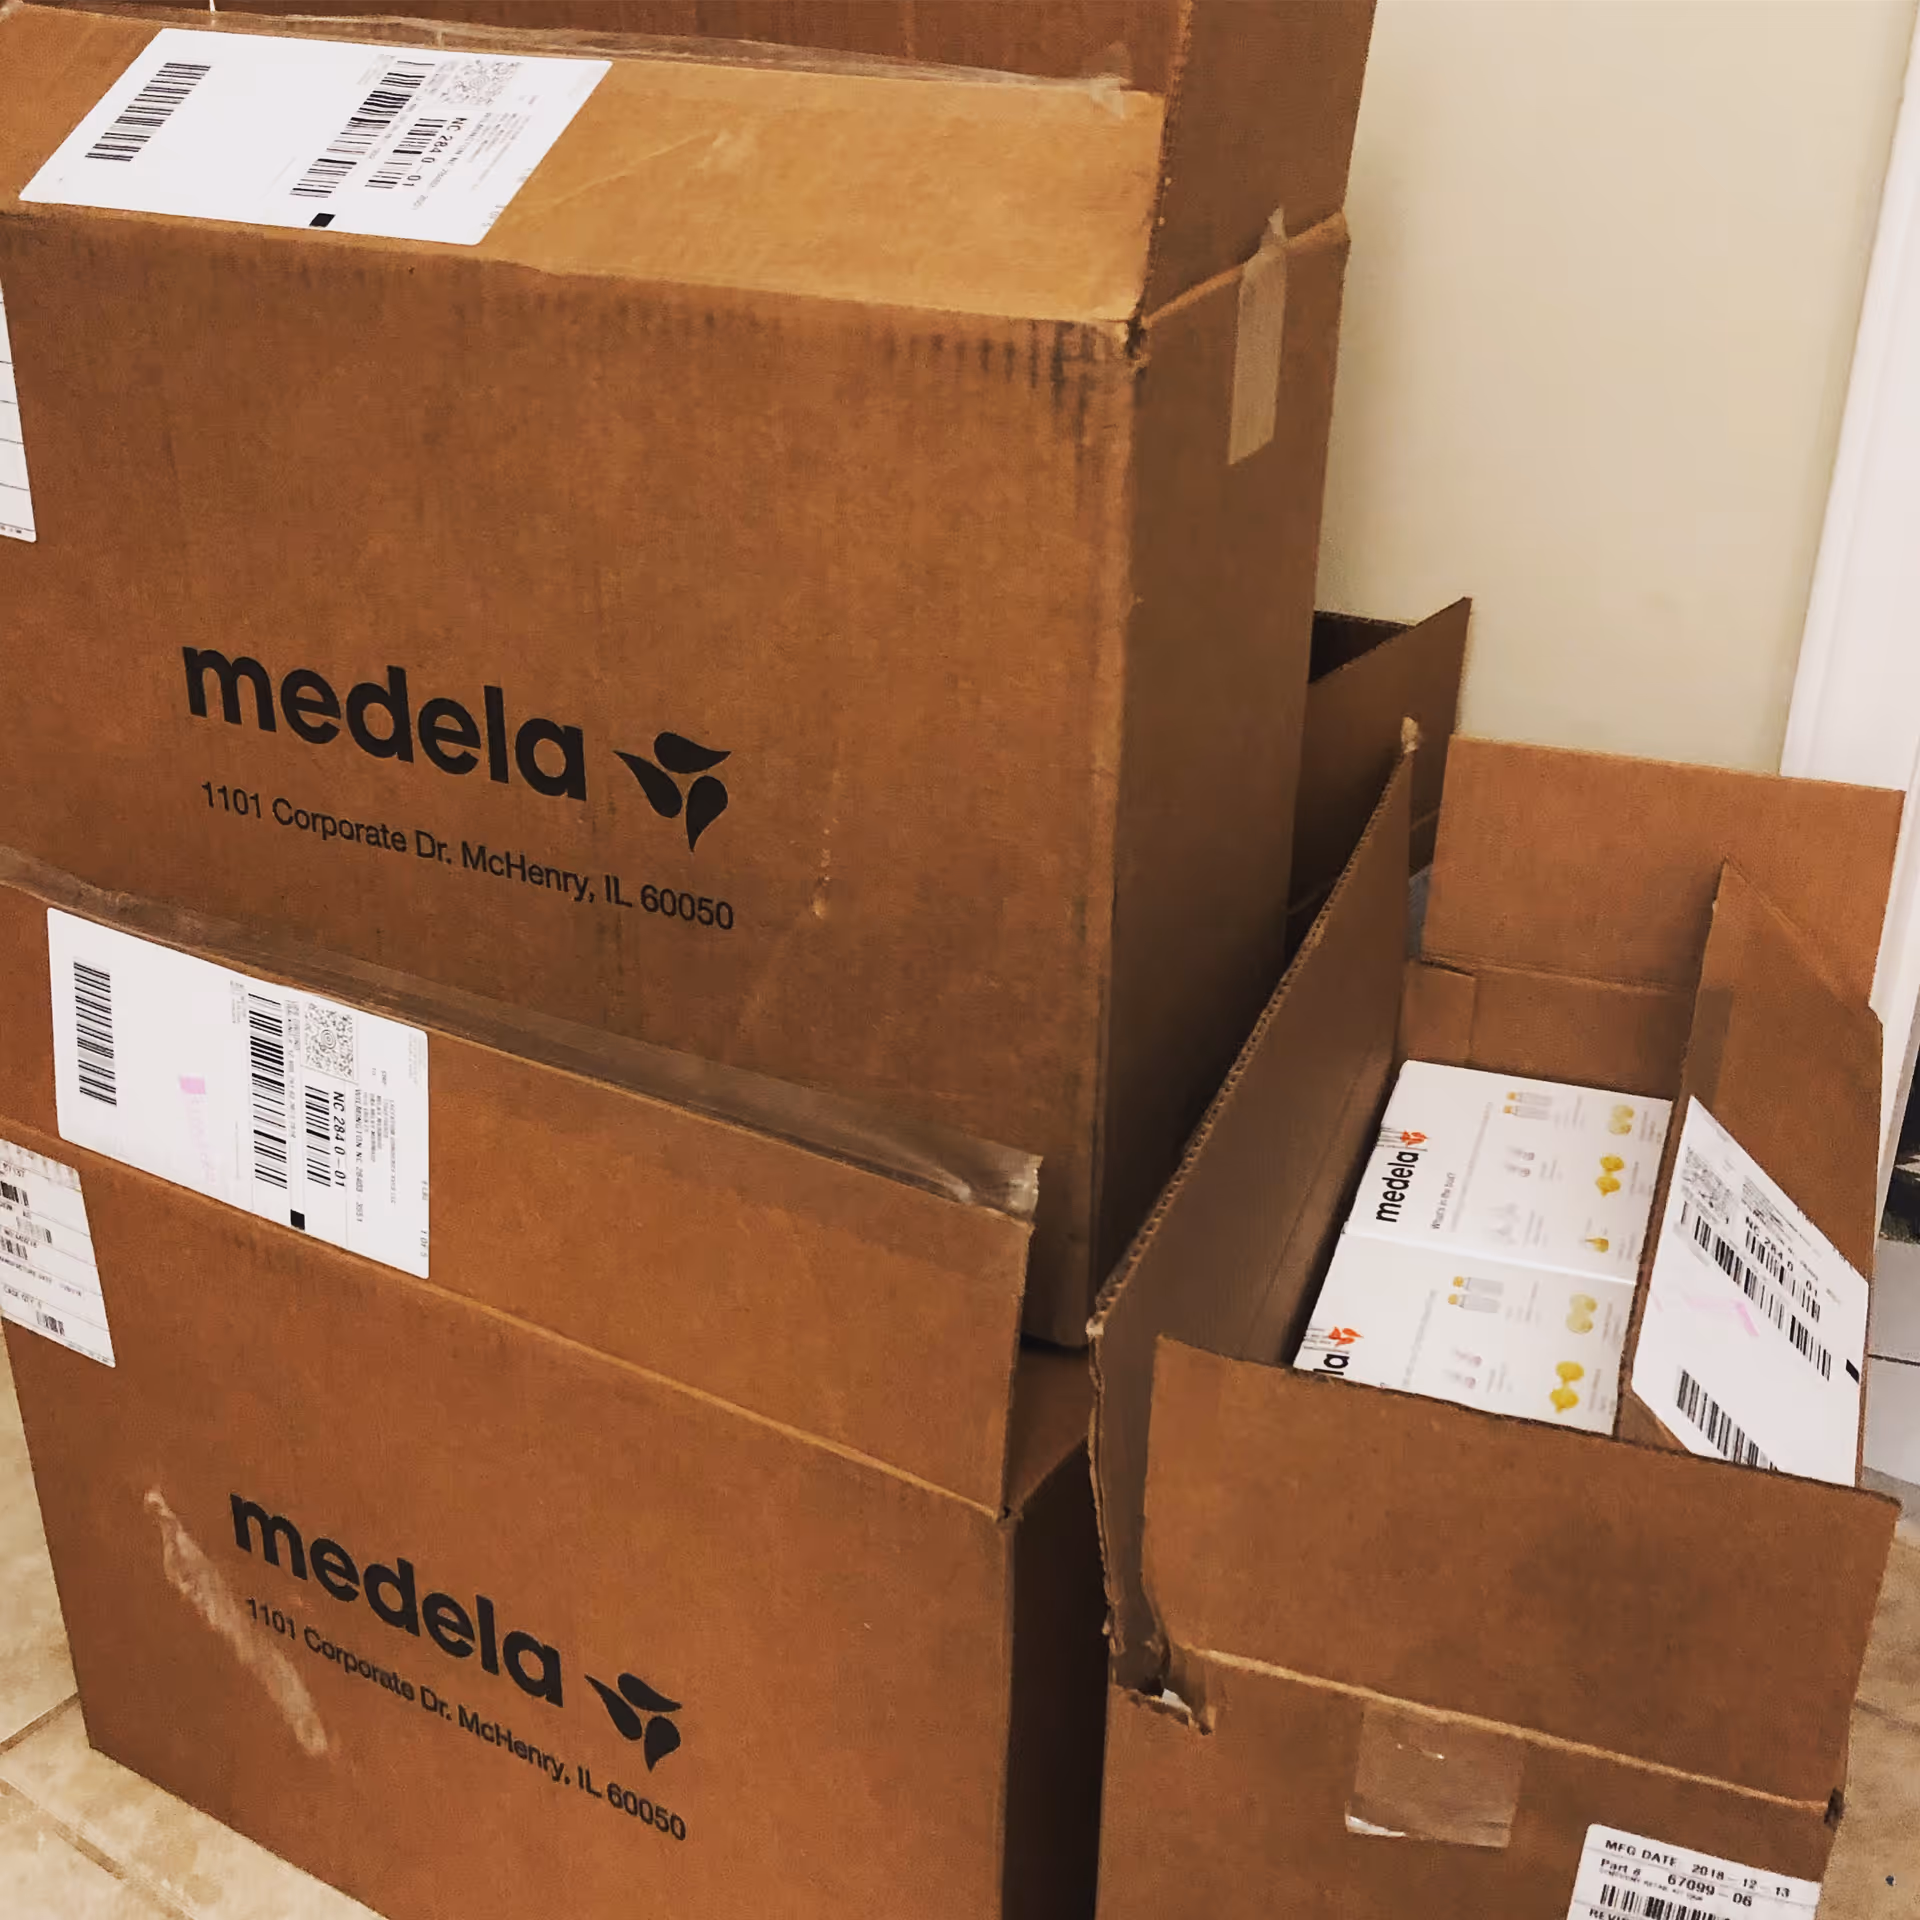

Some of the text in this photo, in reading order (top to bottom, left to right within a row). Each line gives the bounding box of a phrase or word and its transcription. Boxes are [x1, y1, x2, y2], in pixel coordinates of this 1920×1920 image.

[447, 117, 468, 131] NC
[430, 135, 453, 154] 284
[182, 646, 587, 801] medela
[201, 781, 734, 930] 1101 Corporate Dr. McHenry, IL 60050
[333, 1091, 345, 1112] NC
[333, 1116, 346, 1142] 284
[1375, 1151, 1419, 1223] medela
[230, 1493, 563, 1707] medela
[245, 1597, 297, 1641] 1101
[304, 1626, 415, 1701] Corporate
[421, 1686, 452, 1720] Dr.
[578, 1765, 602, 1798] IL
[607, 1783, 686, 1841] 60050
[1600, 1858, 1628, 1876] Part
[1605, 1839, 1636, 1856] MFG
[1642, 1849, 1678, 1867] DATE
